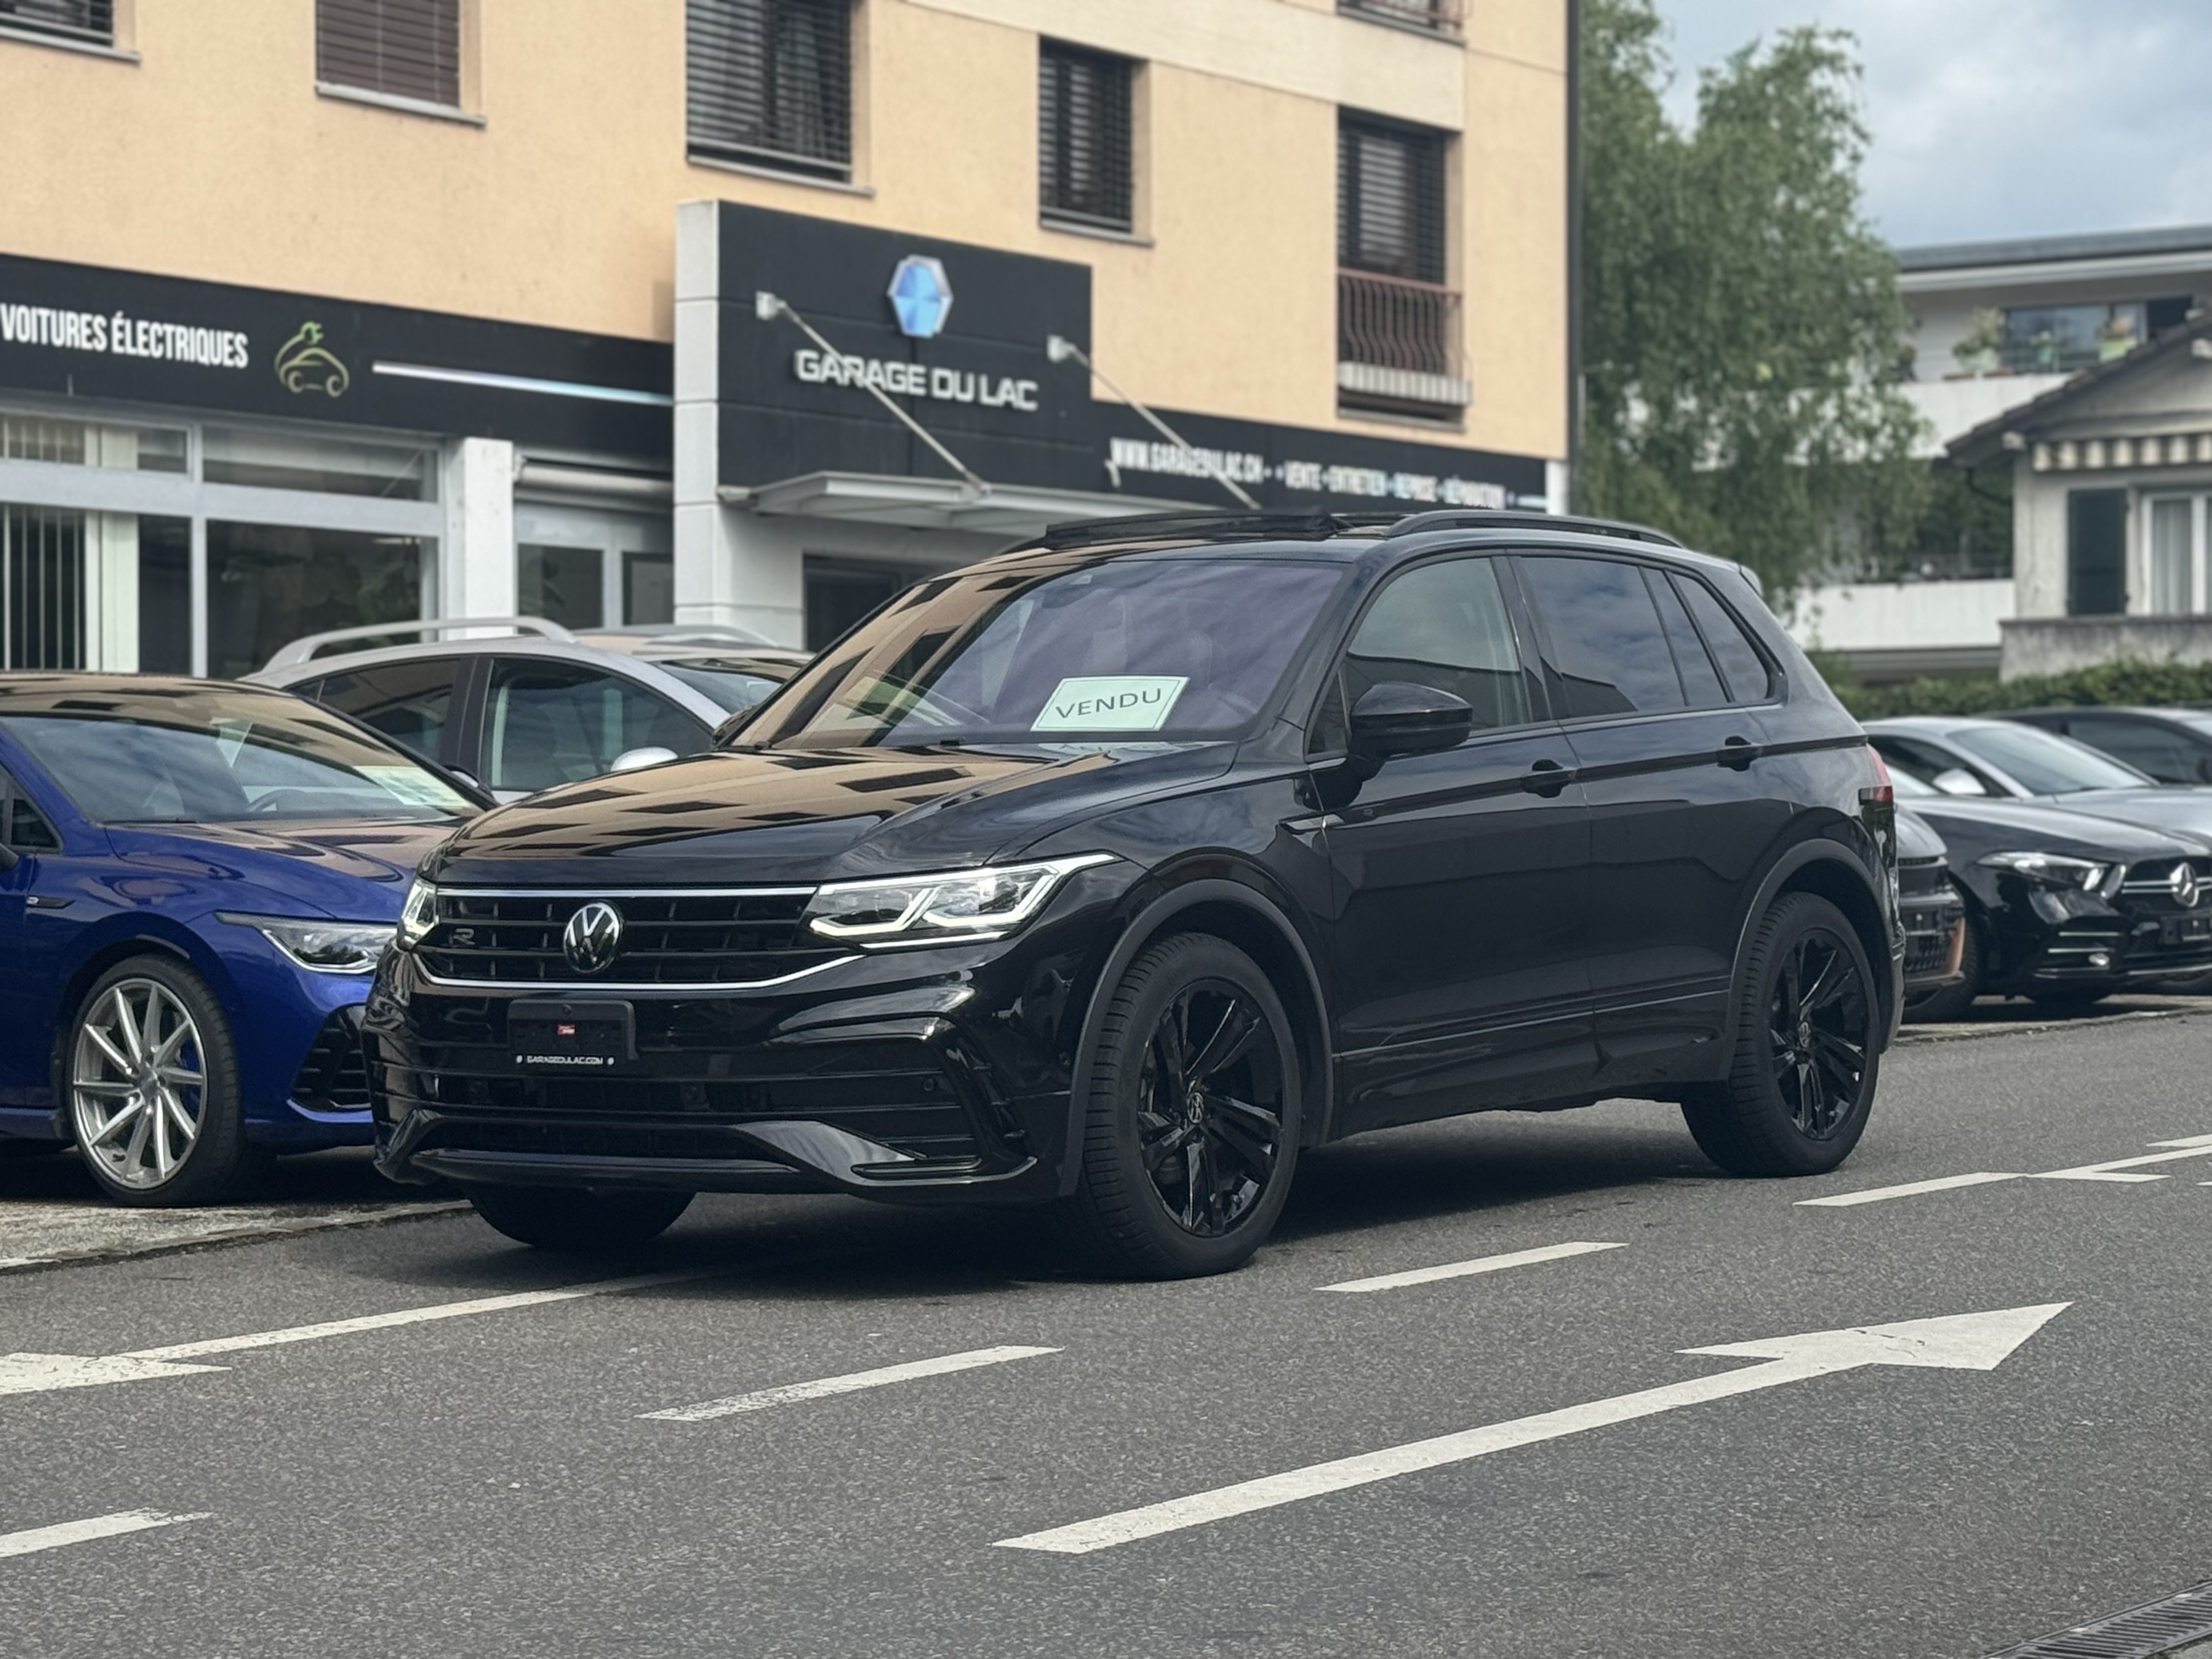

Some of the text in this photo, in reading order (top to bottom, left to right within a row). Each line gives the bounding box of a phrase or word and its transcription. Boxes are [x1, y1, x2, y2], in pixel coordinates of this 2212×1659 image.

[0, 303, 249, 368] VOITURES ÉLECTRIQUES
[795, 349, 1039, 411] GARAGE DU LAC
[1056, 688, 1161, 718] VENDU
